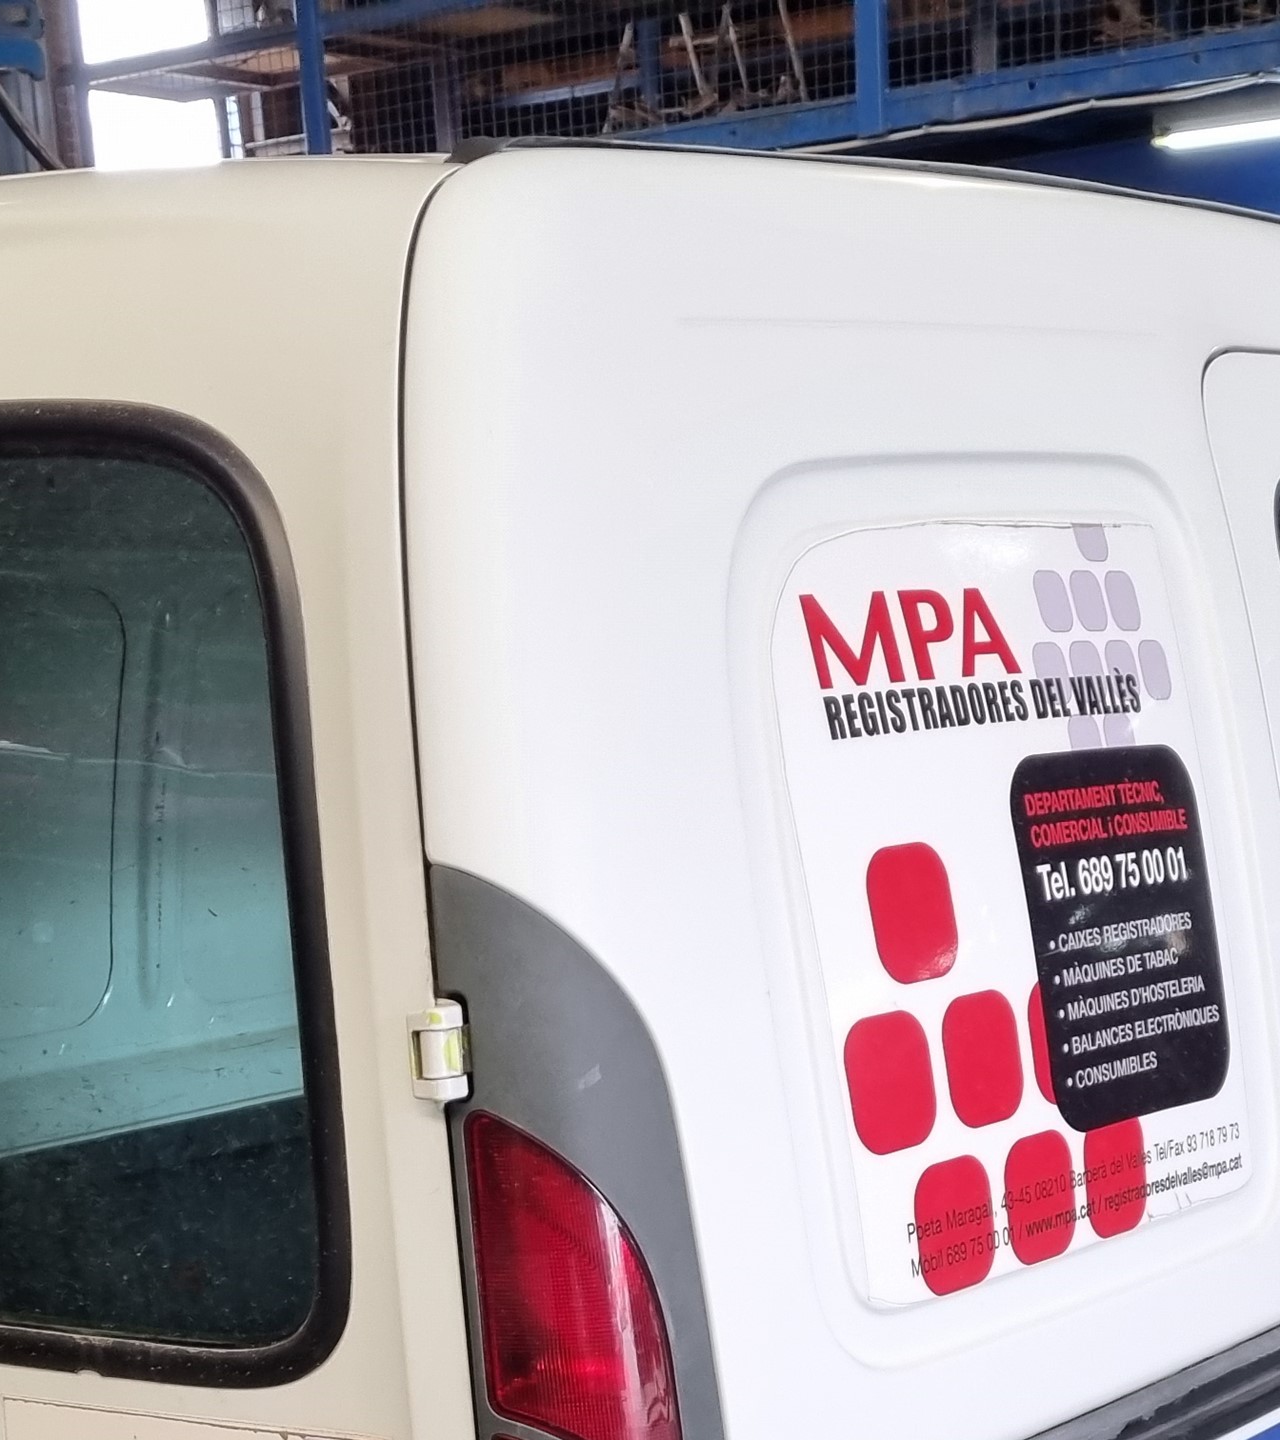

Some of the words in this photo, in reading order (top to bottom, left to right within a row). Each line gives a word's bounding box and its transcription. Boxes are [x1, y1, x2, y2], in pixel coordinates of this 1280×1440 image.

[799, 588, 1022, 689] MPA
[822, 679, 1029, 740] REGISTRADORES
[1029, 675, 1072, 719] DEL
[1072, 668, 1141, 716] VALLÈS
[1024, 784, 1117, 816] DEPARTAMENT
[1117, 778, 1165, 804] TÈCNIC,
[1031, 816, 1108, 848] COMERCIAL
[1107, 817, 1114, 836] i
[1114, 809, 1188, 836] CONSUMIBLE
[1036, 862, 1075, 901] Tel.
[1078, 855, 1113, 895] 689
[1115, 852, 1140, 888] 75
[1142, 848, 1165, 884] 00
[1167, 846, 1188, 882] 01
[1058, 927, 1102, 952] CAIXES
[1103, 912, 1192, 943] REGISTRADORES
[1063, 957, 1125, 987] MÀQUINES
[1127, 954, 1143, 975] DE
[1143, 947, 1179, 970] TABAC
[1067, 990, 1129, 1021] MÀQUINES
[1131, 975, 1205, 1006] D'HOSTELERIA
[1072, 1024, 1133, 1054] BALANCES
[1135, 1004, 1220, 1039] ELECTRÒNIQUES
[1076, 1051, 1158, 1088] CONSUMIBLES
[907, 1217, 943, 1243] Poeta
[1001, 1187, 1032, 1210] 43-45
[1034, 1174, 1066, 1201] 08210
[1110, 1155, 1125, 1175] del
[1154, 1139, 1185, 1163] Tel/Fax
[1186, 1134, 1198, 1153] 93
[1199, 1129, 1215, 1150] 718
[1217, 1125, 1228, 1144] 79
[1229, 1122, 1240, 1140] 73
[946, 1241, 968, 1266] 689
[970, 1236, 984, 1255] 75
[986, 1230, 1000, 1250] 00
[1003, 1226, 1016, 1246] 01
[1025, 1198, 1096, 1238] www.mpa.cat
[1104, 1152, 1243, 1211] registradoresdelvalles@mpa.cat
